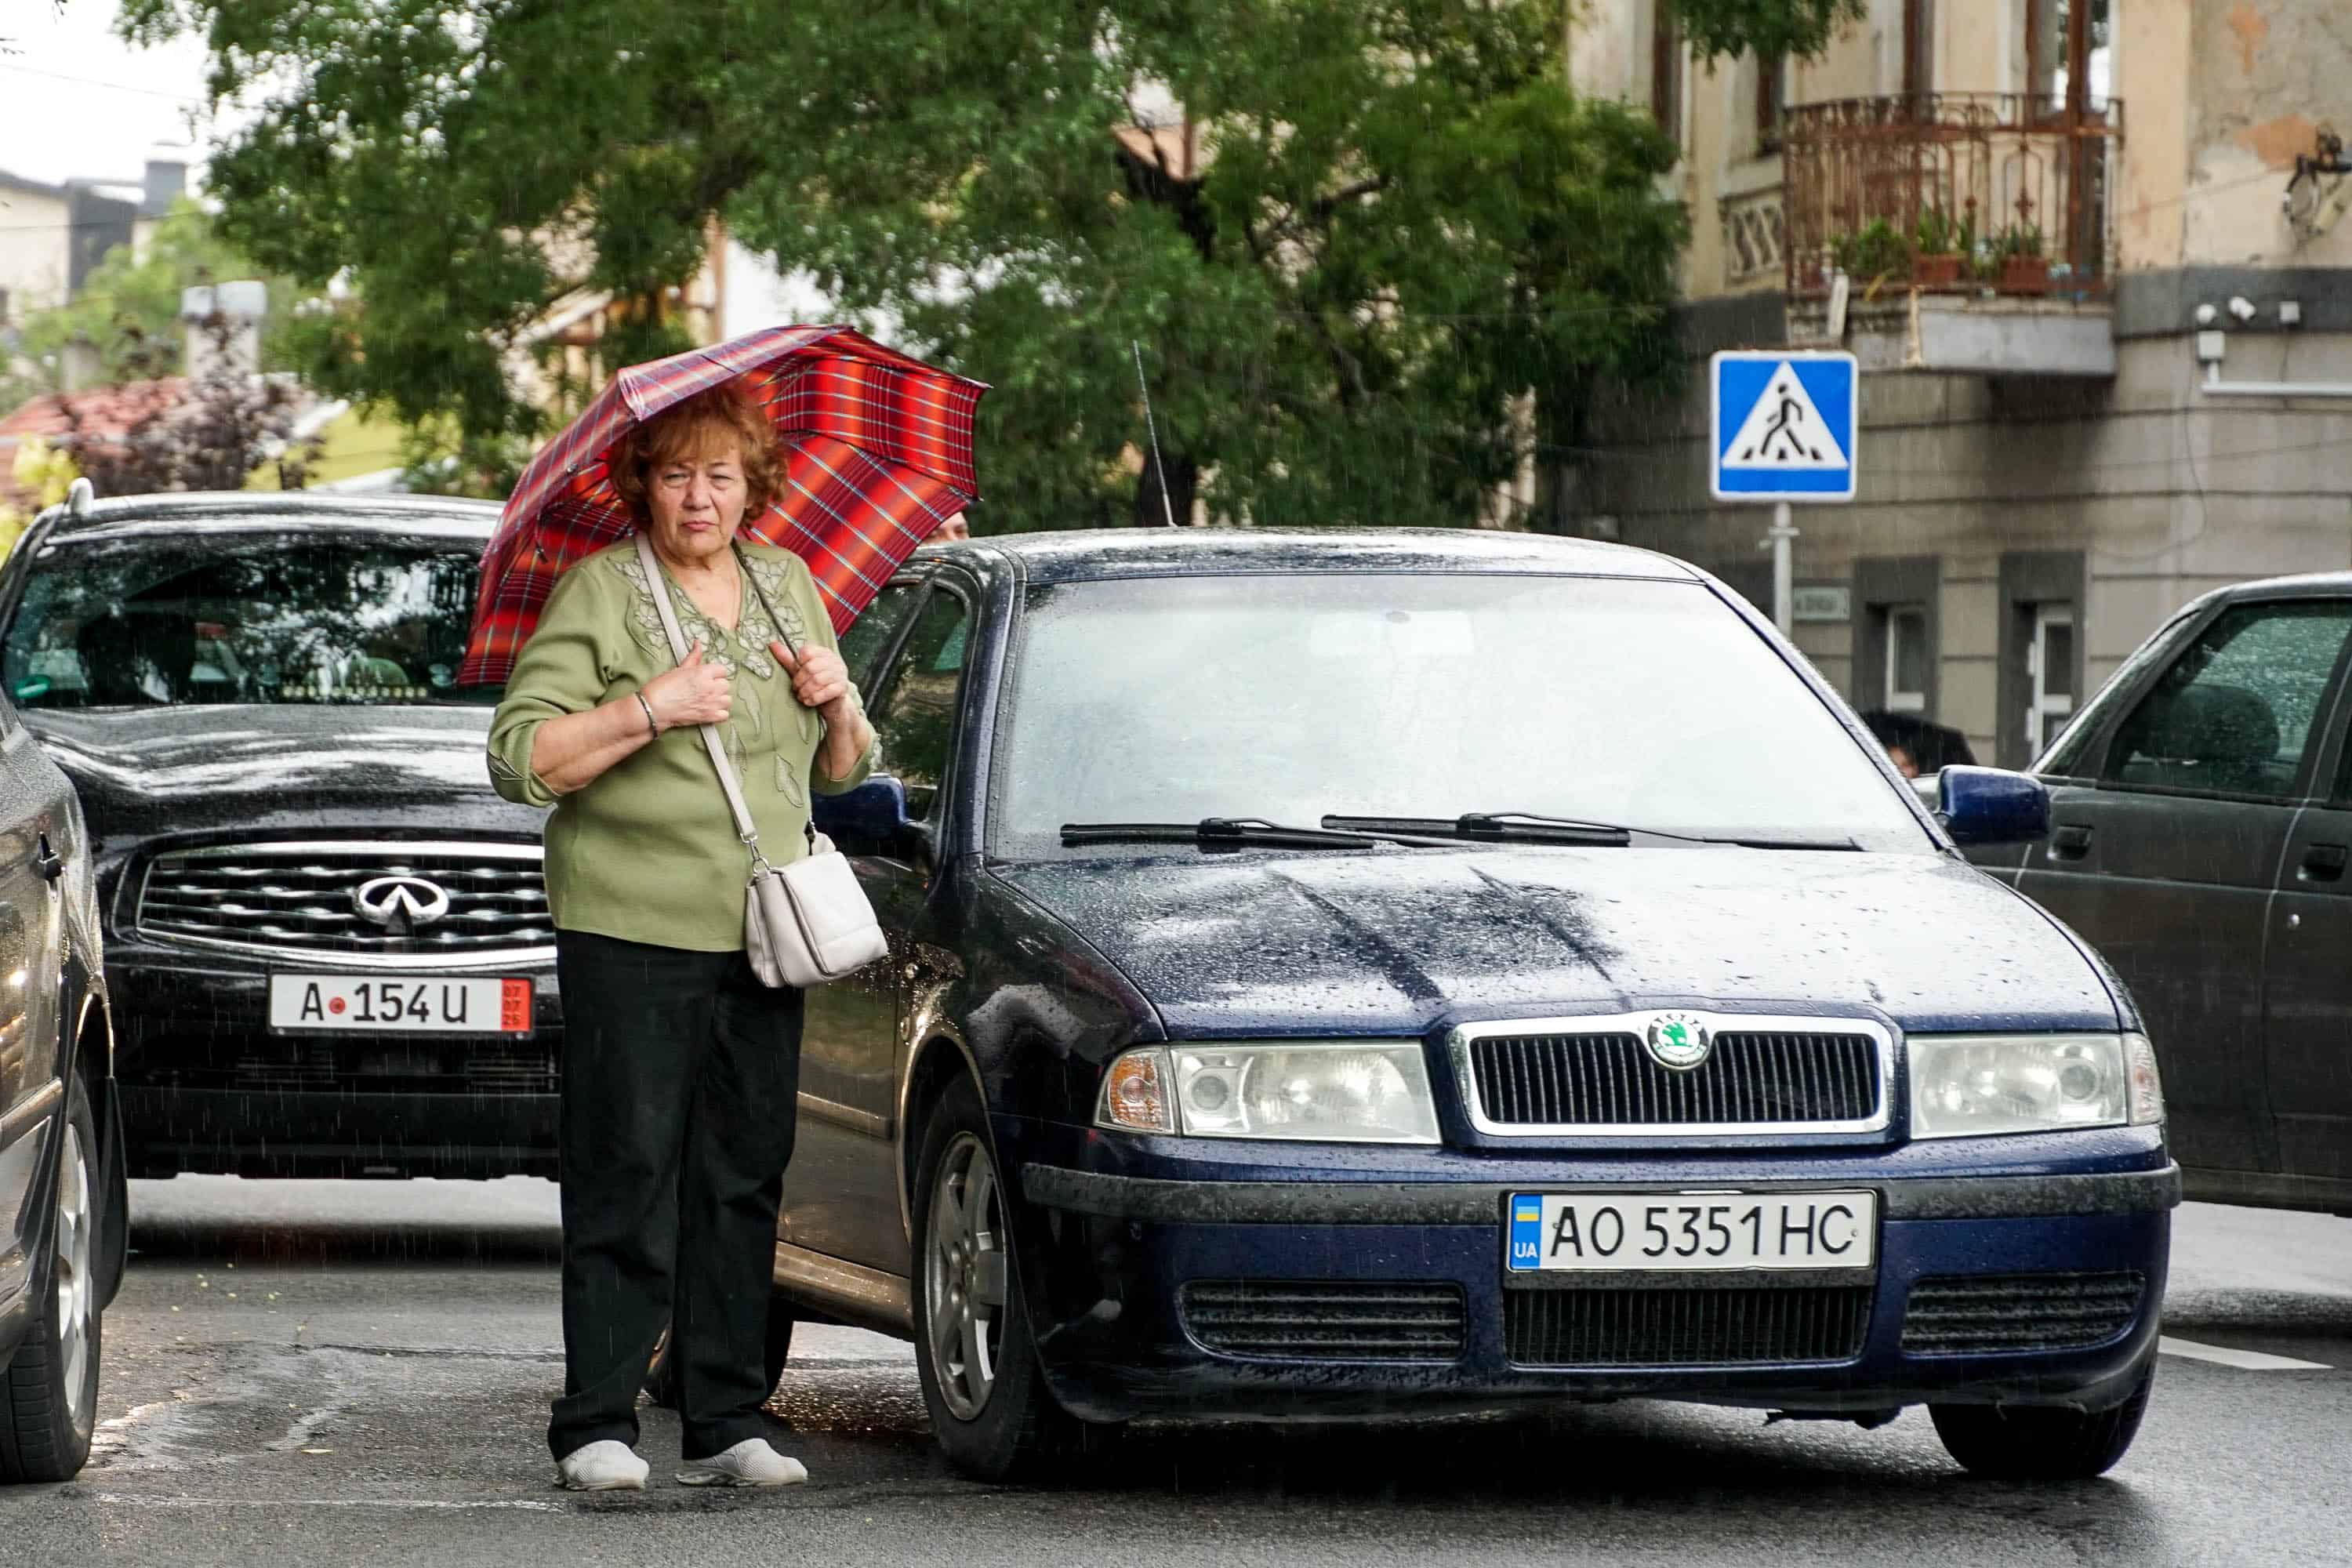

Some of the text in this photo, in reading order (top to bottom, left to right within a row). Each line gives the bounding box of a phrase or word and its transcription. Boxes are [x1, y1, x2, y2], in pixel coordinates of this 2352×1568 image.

[1551, 1205, 1854, 1256] AO 5351 HC
[1515, 1242, 1537, 1258] UA
